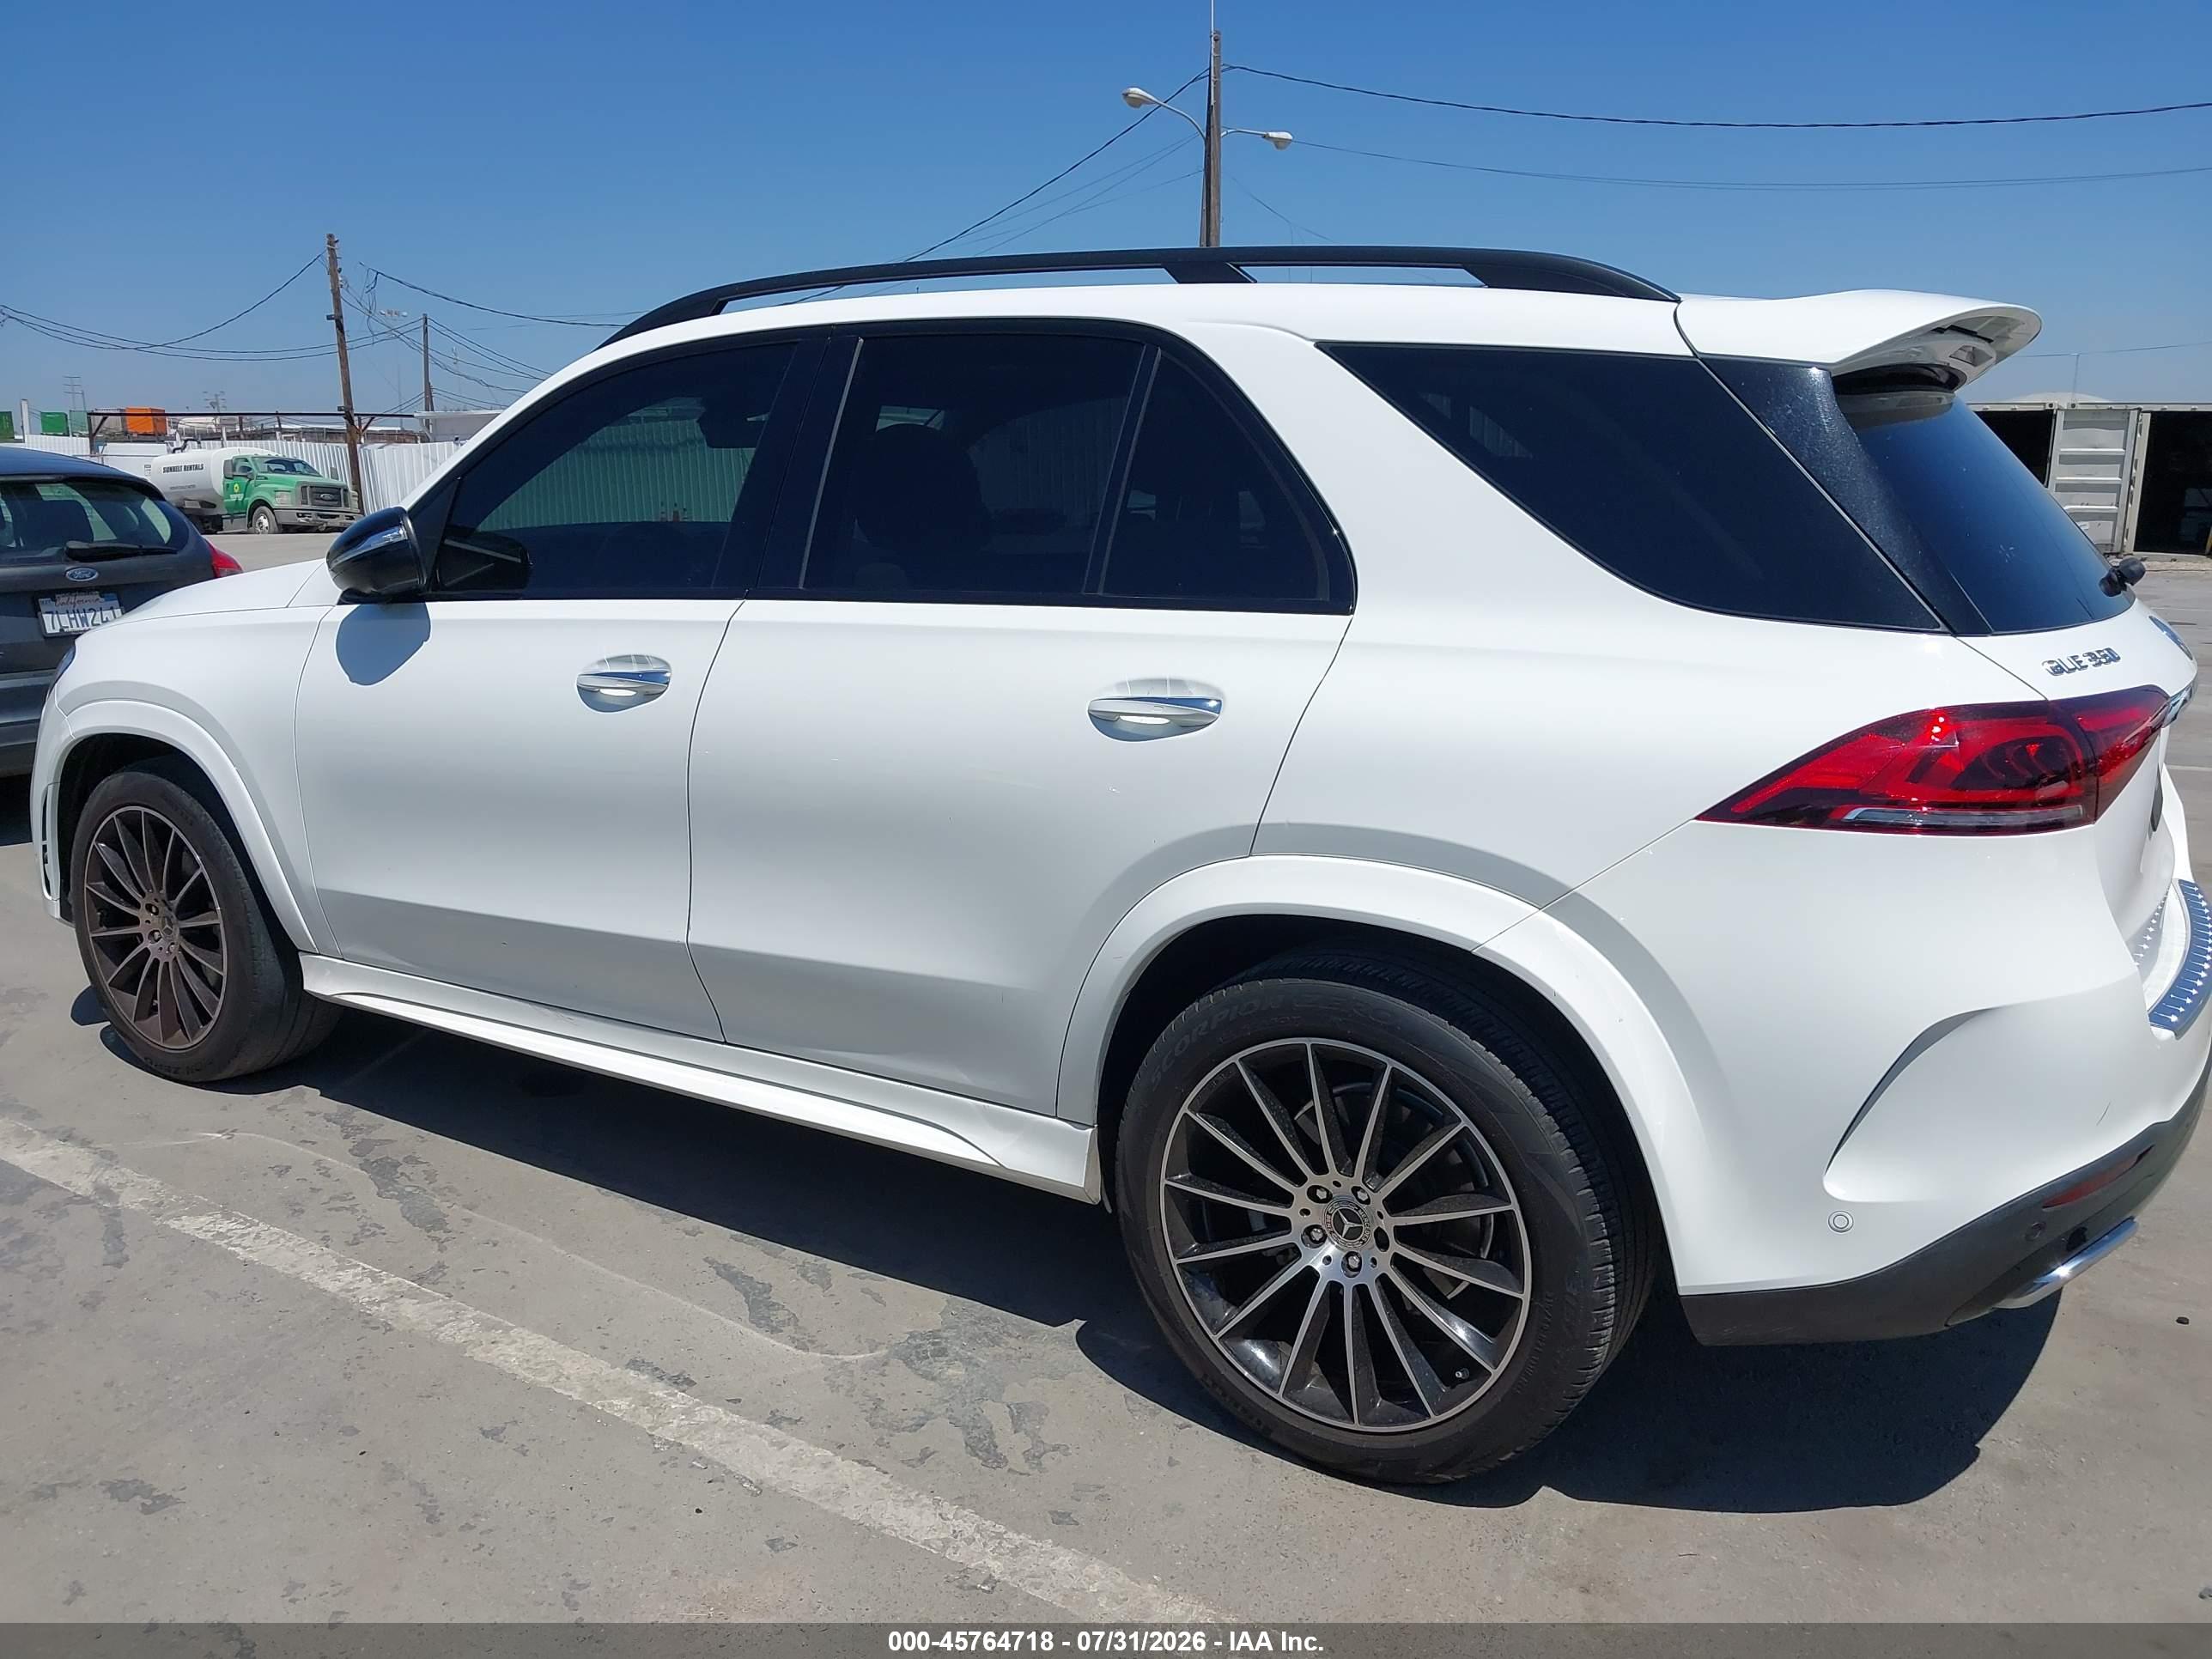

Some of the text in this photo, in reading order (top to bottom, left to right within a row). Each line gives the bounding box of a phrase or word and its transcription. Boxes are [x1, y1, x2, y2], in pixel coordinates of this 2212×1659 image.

[162, 465, 183, 474] SUNBELT
[183, 463, 204, 472] RENTALS
[2042, 647, 2121, 677] GLE 350
[1151, 994, 1285, 1092] SCORPION
